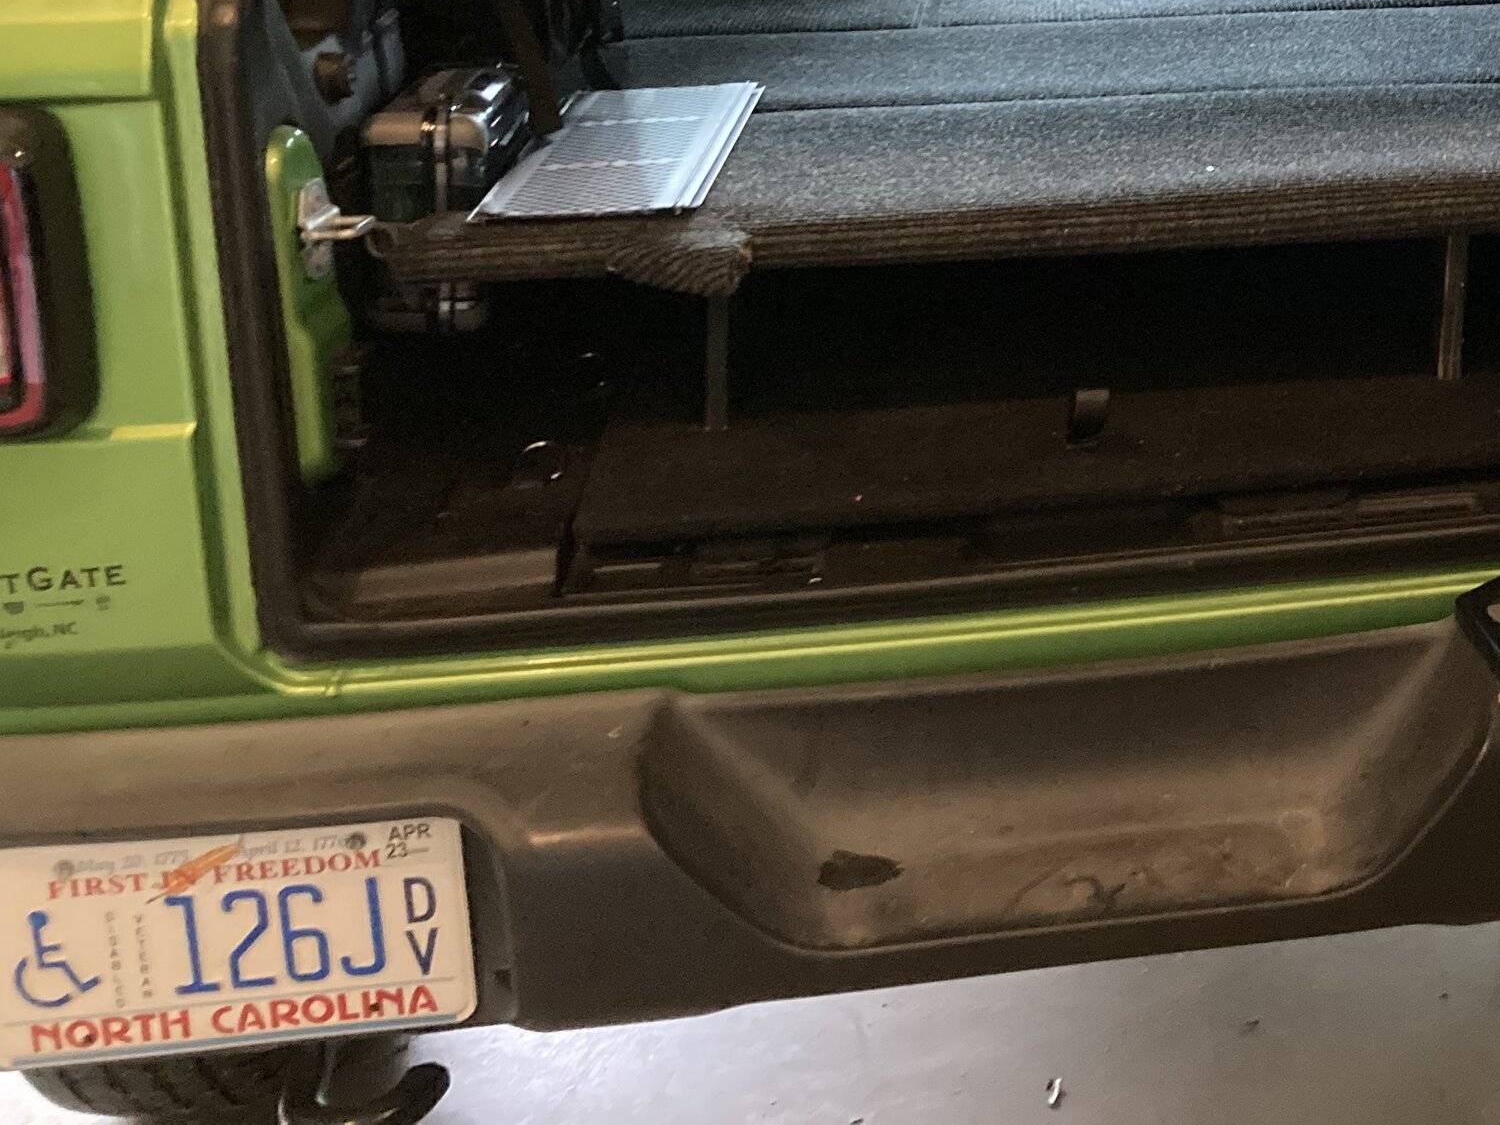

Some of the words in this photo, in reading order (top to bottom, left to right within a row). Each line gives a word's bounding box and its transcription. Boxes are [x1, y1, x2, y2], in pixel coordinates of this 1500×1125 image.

[386, 842, 408, 860] 23
[388, 823, 431, 843] APR
[48, 871, 148, 900] FIRST
[213, 848, 382, 885] FREEDOM
[164, 876, 387, 996] 126J
[31, 1009, 192, 1053] NORTH
[210, 984, 439, 1034] CAROLINA
